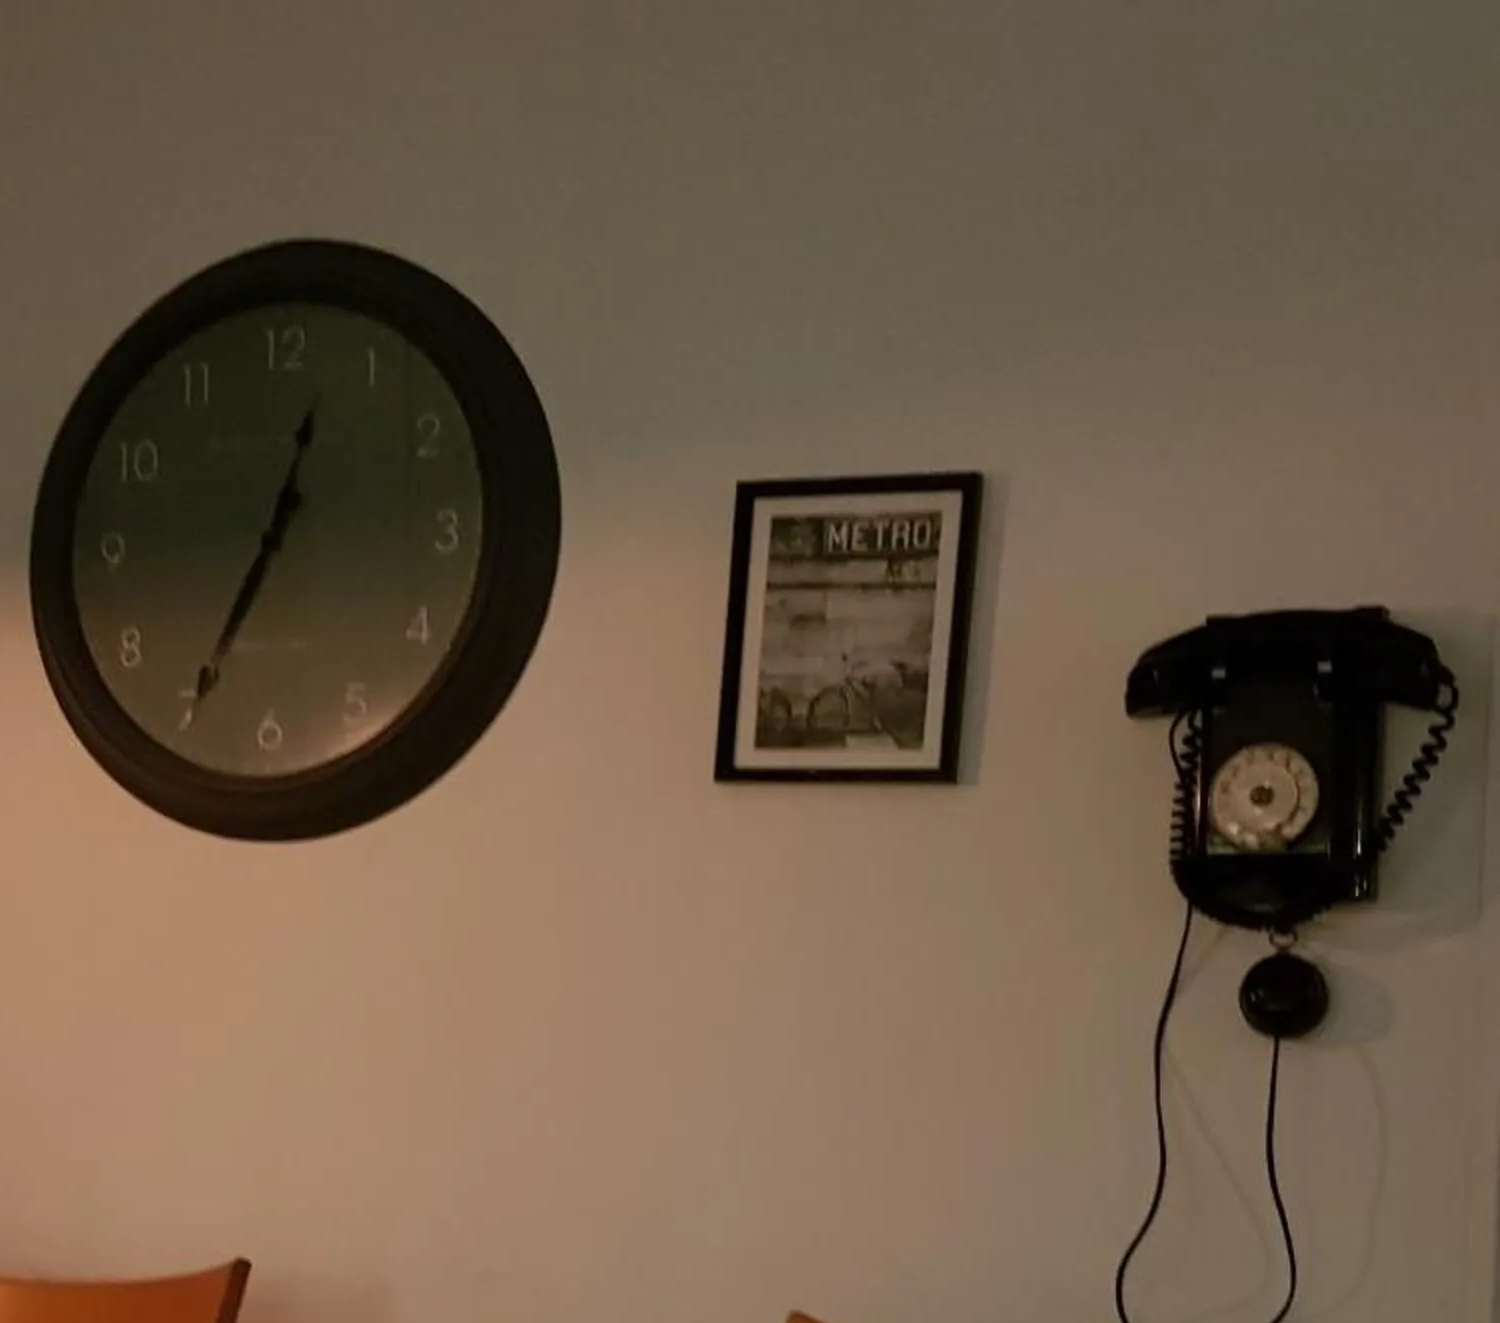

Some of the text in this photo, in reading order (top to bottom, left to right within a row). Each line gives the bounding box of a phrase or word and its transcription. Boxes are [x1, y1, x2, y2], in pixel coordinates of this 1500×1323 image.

[264, 326, 307, 371] 12
[367, 347, 375, 387] 1
[182, 362, 210, 405] 11
[416, 415, 441, 458] 2
[119, 438, 160, 482] 10
[100, 529, 126, 570] 9
[435, 508, 460, 552] 3
[827, 519, 932, 553] METRO
[118, 625, 142, 669] 8
[405, 605, 433, 646] 4
[342, 683, 367, 724] 5
[257, 705, 283, 750] 6
